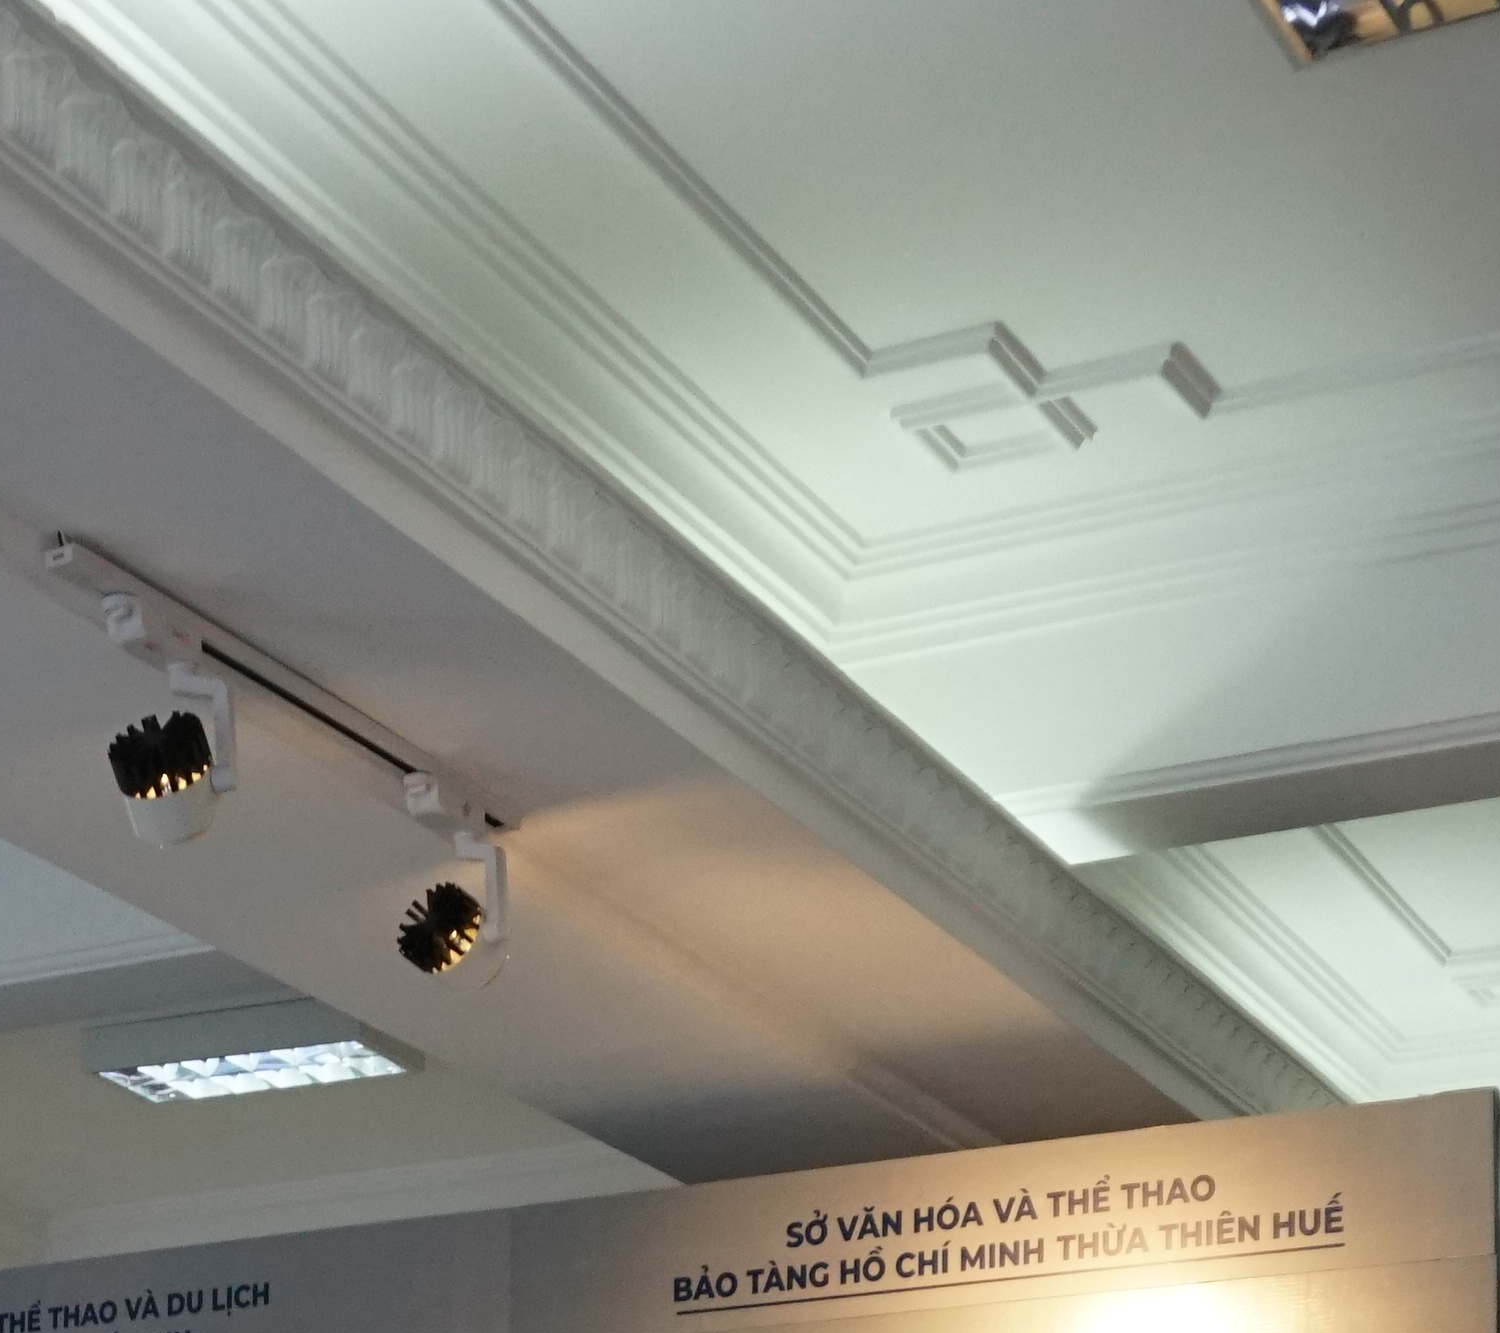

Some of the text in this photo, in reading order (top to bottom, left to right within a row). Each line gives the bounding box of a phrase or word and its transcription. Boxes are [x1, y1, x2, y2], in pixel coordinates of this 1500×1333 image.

[786, 1174, 1216, 1247] SỞ VĂN HÓA VÀ THỂ THAO
[674, 1192, 1343, 1303] BẢO TÀNG HỒ CHÍ MINH THỪA THIÊN HUẾ
[48, 1300, 117, 1329] THAO
[124, 1289, 159, 1321] VÀ
[167, 1289, 204, 1316] DU
[211, 1283, 270, 1317] LỊCH
